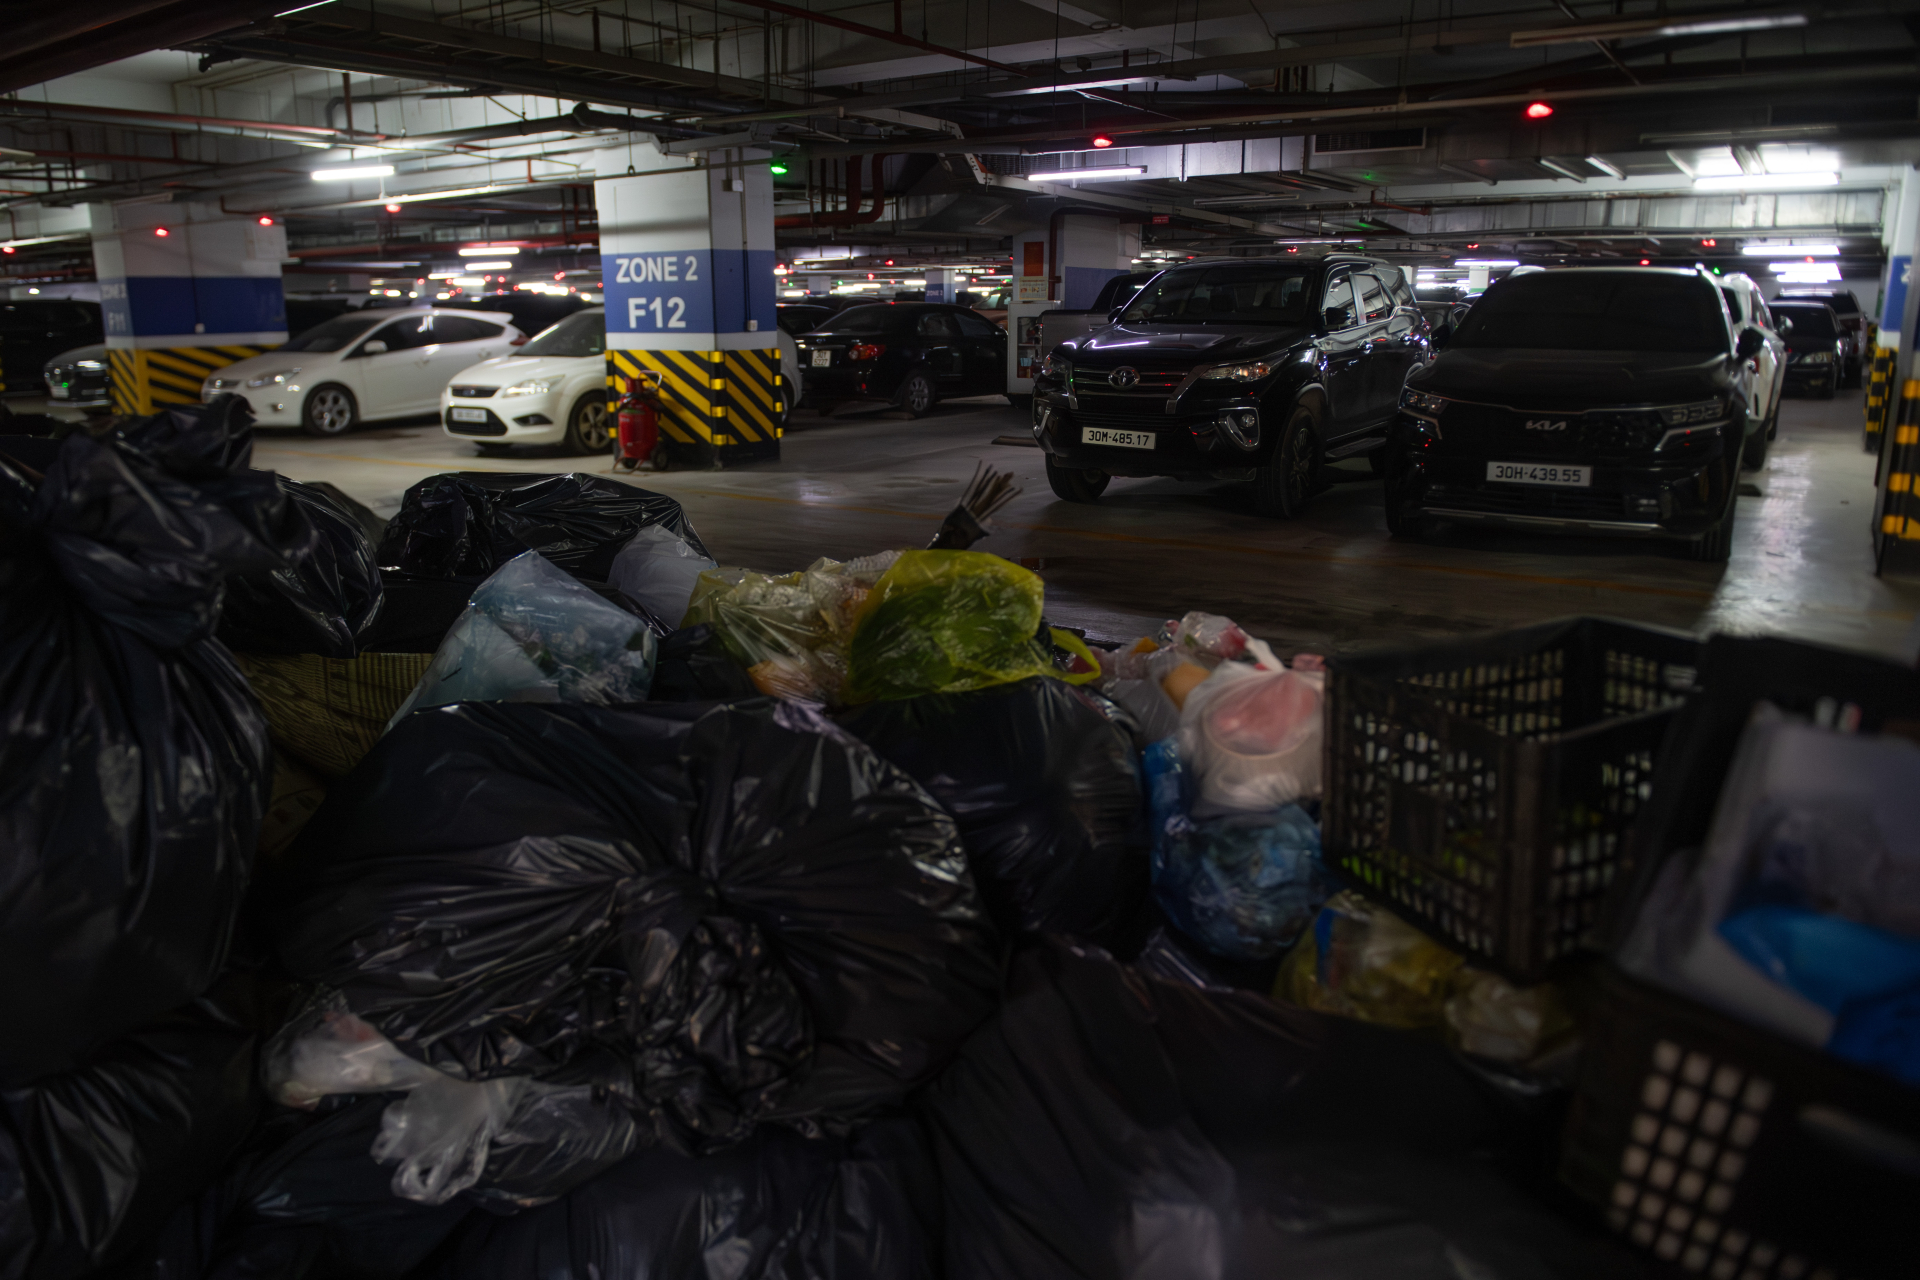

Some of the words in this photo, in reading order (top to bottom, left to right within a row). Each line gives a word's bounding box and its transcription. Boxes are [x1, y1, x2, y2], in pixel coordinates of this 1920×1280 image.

[615, 256, 678, 283] ZONE
[685, 255, 698, 281] 2
[926, 289, 940, 297] ZONE
[628, 297, 686, 329] F12
[1088, 430, 1150, 446] 30M-485.17
[1495, 465, 1582, 483] 30H-439.55
